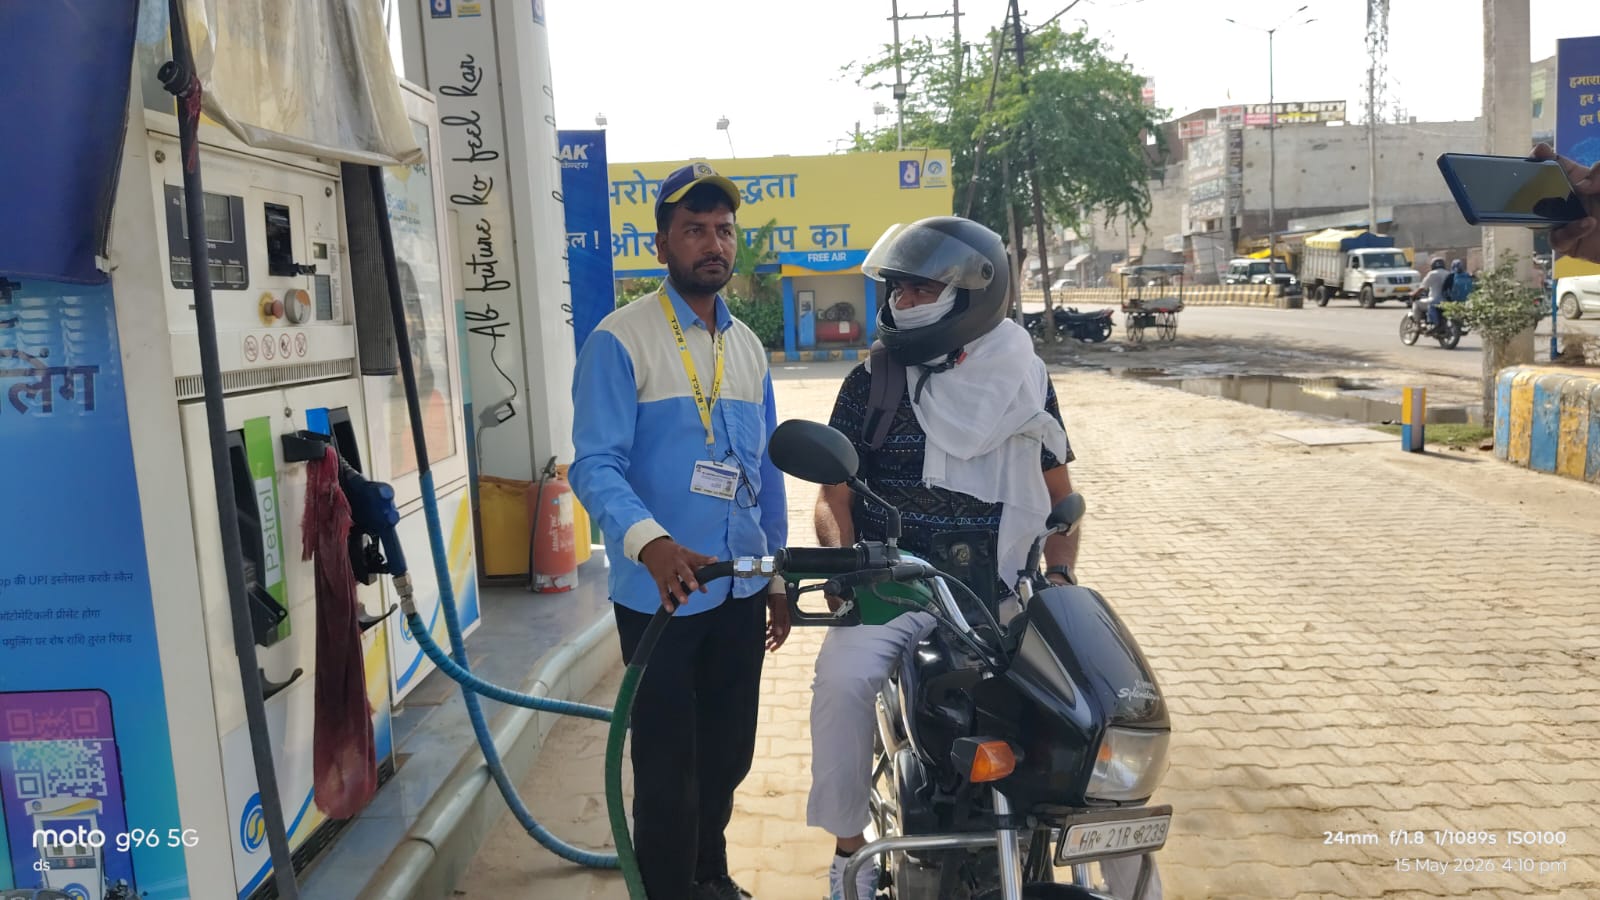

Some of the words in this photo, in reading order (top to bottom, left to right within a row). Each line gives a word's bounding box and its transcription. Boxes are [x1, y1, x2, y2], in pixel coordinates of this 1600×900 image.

[439, 54, 483, 96] kar
[441, 110, 499, 163] feel
[450, 174, 493, 205] ko
[809, 224, 850, 249] का
[465, 218, 511, 292] future
[808, 253, 830, 262] FREE
[832, 252, 847, 261] AIR
[258, 488, 280, 573] Petrol
[28, 575, 48, 586] UPI
